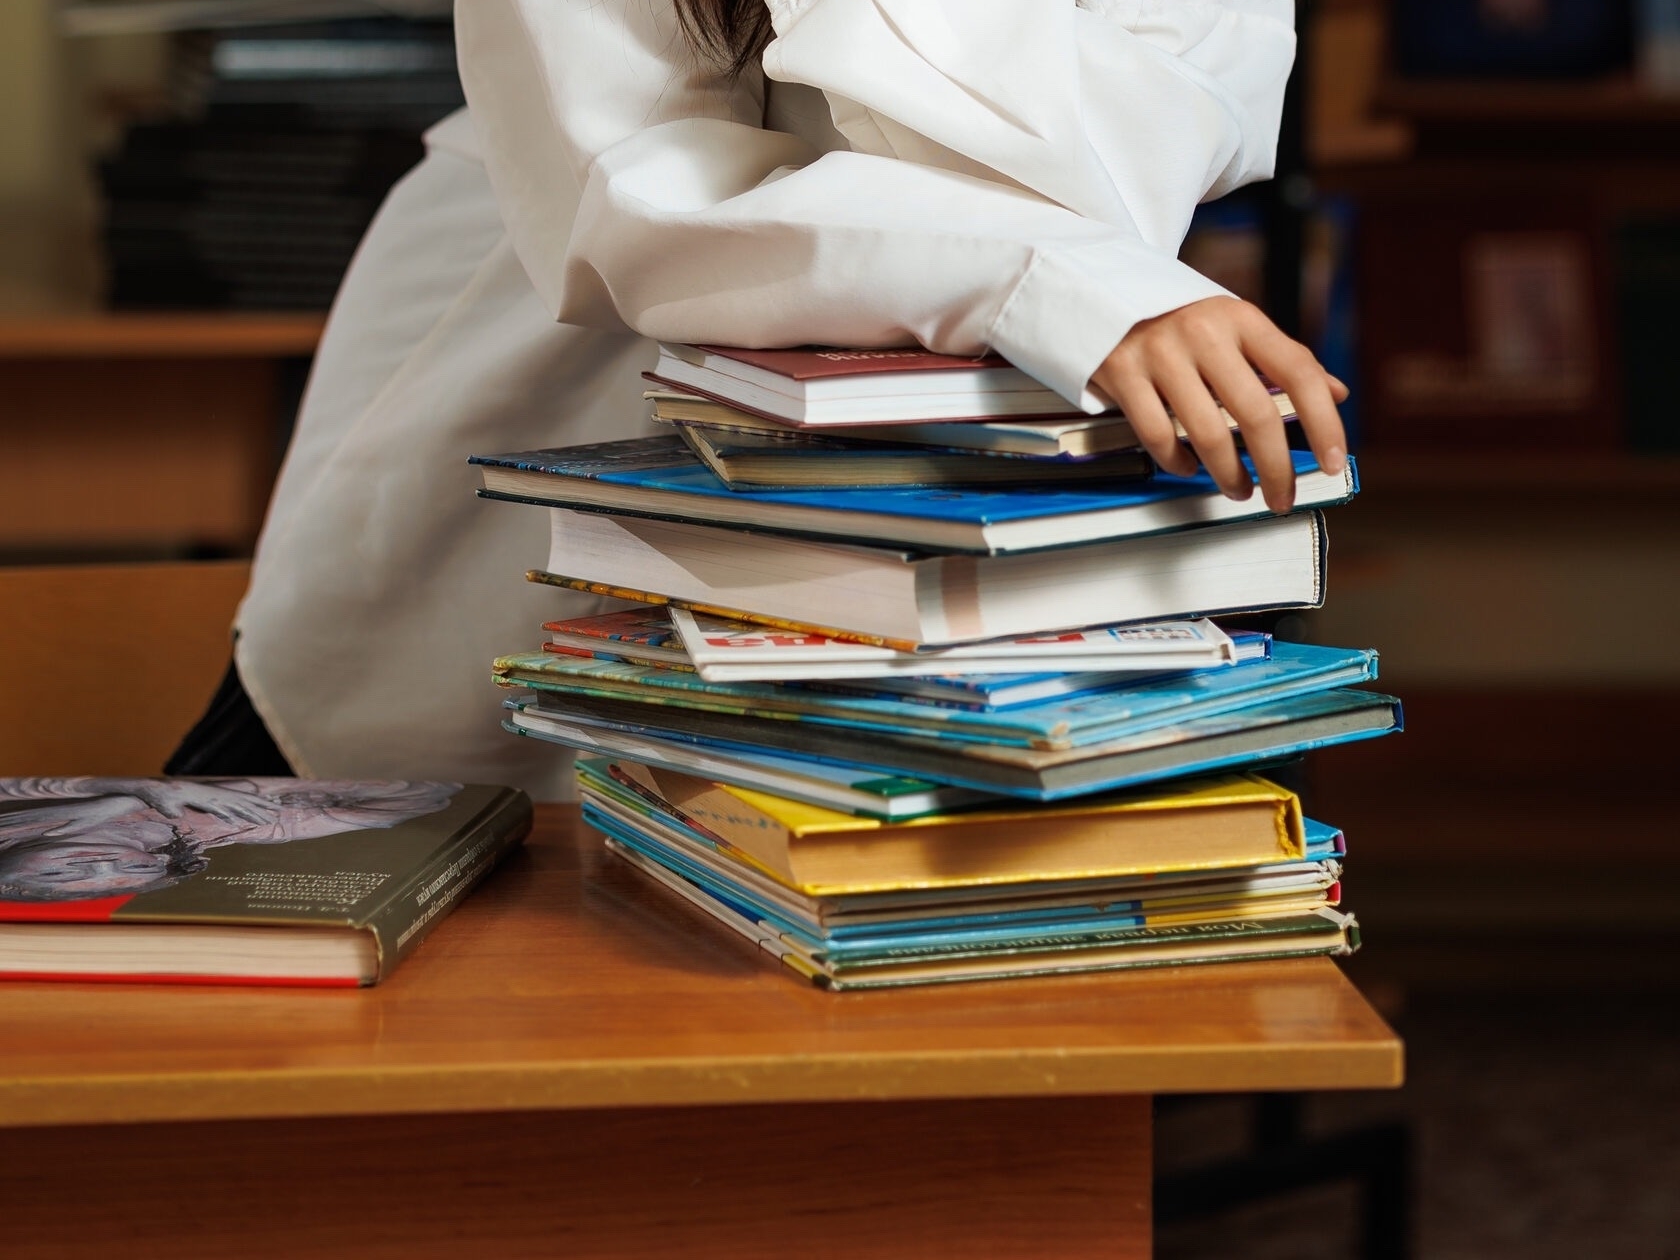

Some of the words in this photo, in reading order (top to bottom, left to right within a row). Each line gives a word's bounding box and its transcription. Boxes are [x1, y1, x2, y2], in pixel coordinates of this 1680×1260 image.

[1095, 927, 1189, 941] первая
[1197, 921, 1265, 933] Моя
[887, 934, 1088, 956] энциклопедия
